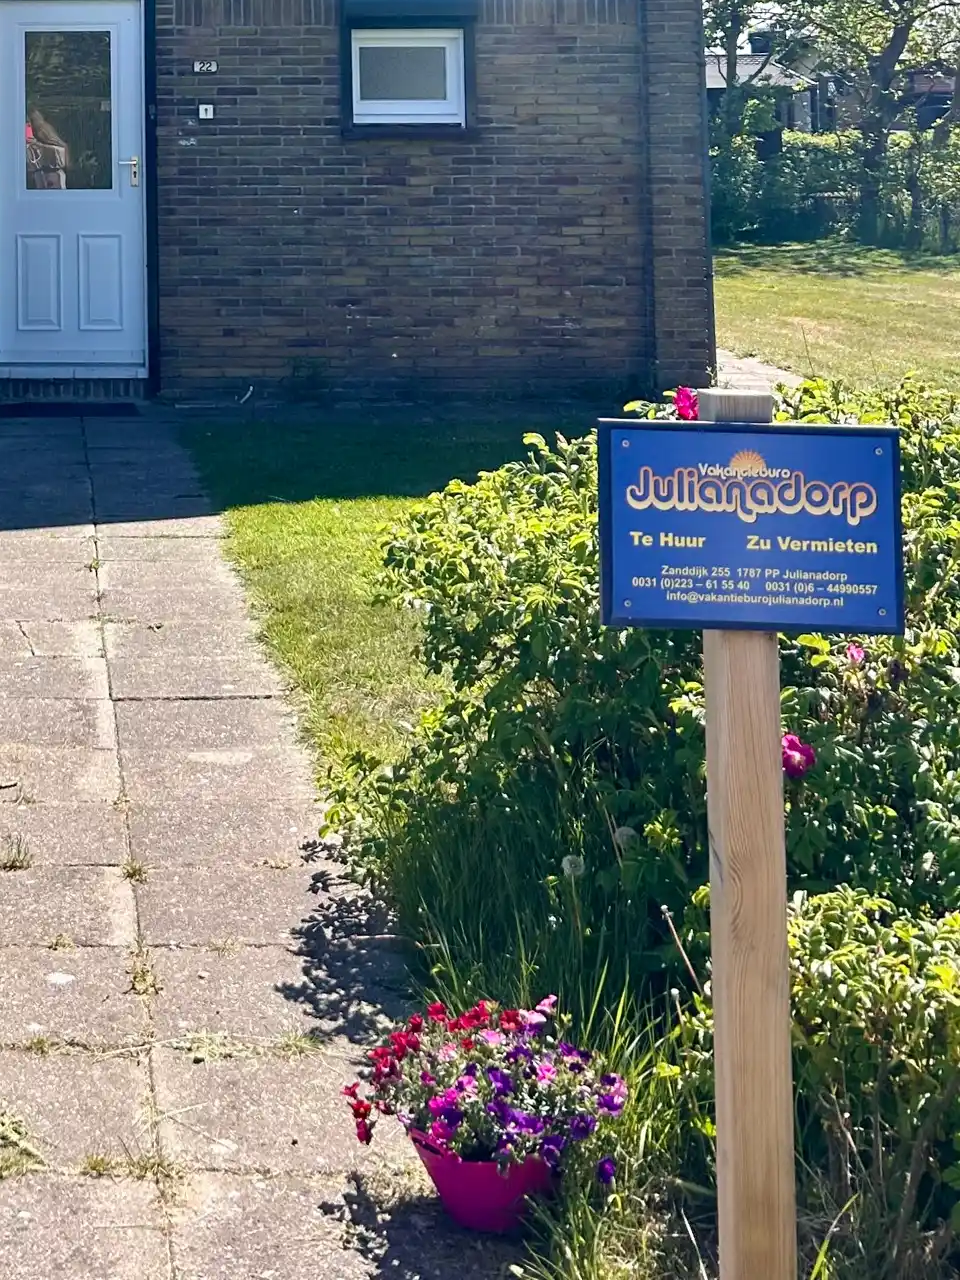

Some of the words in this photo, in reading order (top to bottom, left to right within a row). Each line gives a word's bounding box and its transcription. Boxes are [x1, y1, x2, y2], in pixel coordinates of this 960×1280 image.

[199, 62, 212, 72] 22
[626, 465, 877, 526] Julianadorp
[630, 531, 653, 546] Te
[660, 533, 706, 548] Huur
[746, 535, 771, 550] Zu
[777, 536, 878, 553] Vermieten
[661, 565, 708, 578] Zanddijk
[711, 567, 731, 577] 255
[737, 568, 761, 578] 1787
[765, 569, 780, 578] PP
[782, 570, 848, 582] Julianadorp
[632, 577, 657, 587] 0031
[660, 578, 693, 589] (0)223
[706, 579, 718, 589] 61
[721, 580, 734, 590] 55
[737, 580, 750, 590] 40
[766, 582, 790, 592] 0031
[794, 582, 814, 594] (0)6
[826, 583, 878, 595] 44990557
[666, 591, 844, 607] info@vakantieburojulianadorp.nl
